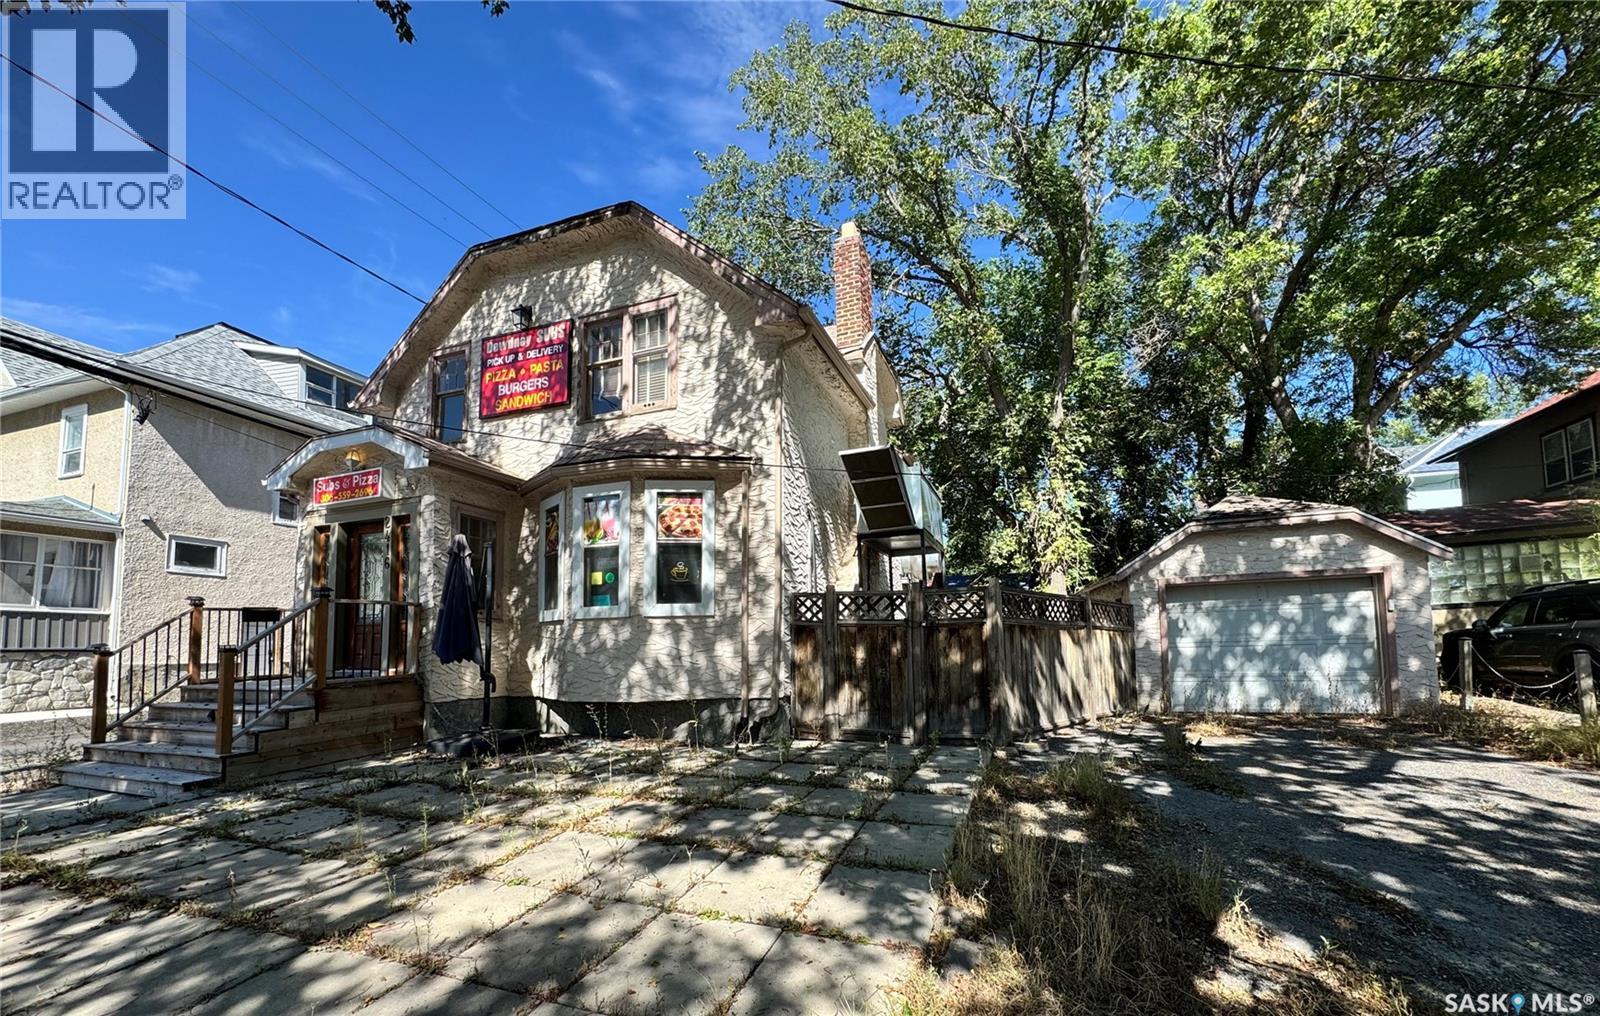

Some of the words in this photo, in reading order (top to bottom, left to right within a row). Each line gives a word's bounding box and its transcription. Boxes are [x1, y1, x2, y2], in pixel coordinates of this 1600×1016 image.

[536, 324, 566, 343] SUBS
[487, 357, 503, 367] PICK
[505, 354, 515, 363] UP
[517, 352, 524, 361] &
[526, 344, 564, 358] DELIVERY
[485, 368, 516, 384] PIZZA
[530, 359, 564, 376] PASTA
[498, 376, 549, 396] BURGERS
[495, 390, 553, 413] SANDWICH
[316, 479, 340, 493] Subs
[352, 474, 379, 487] Pizza
